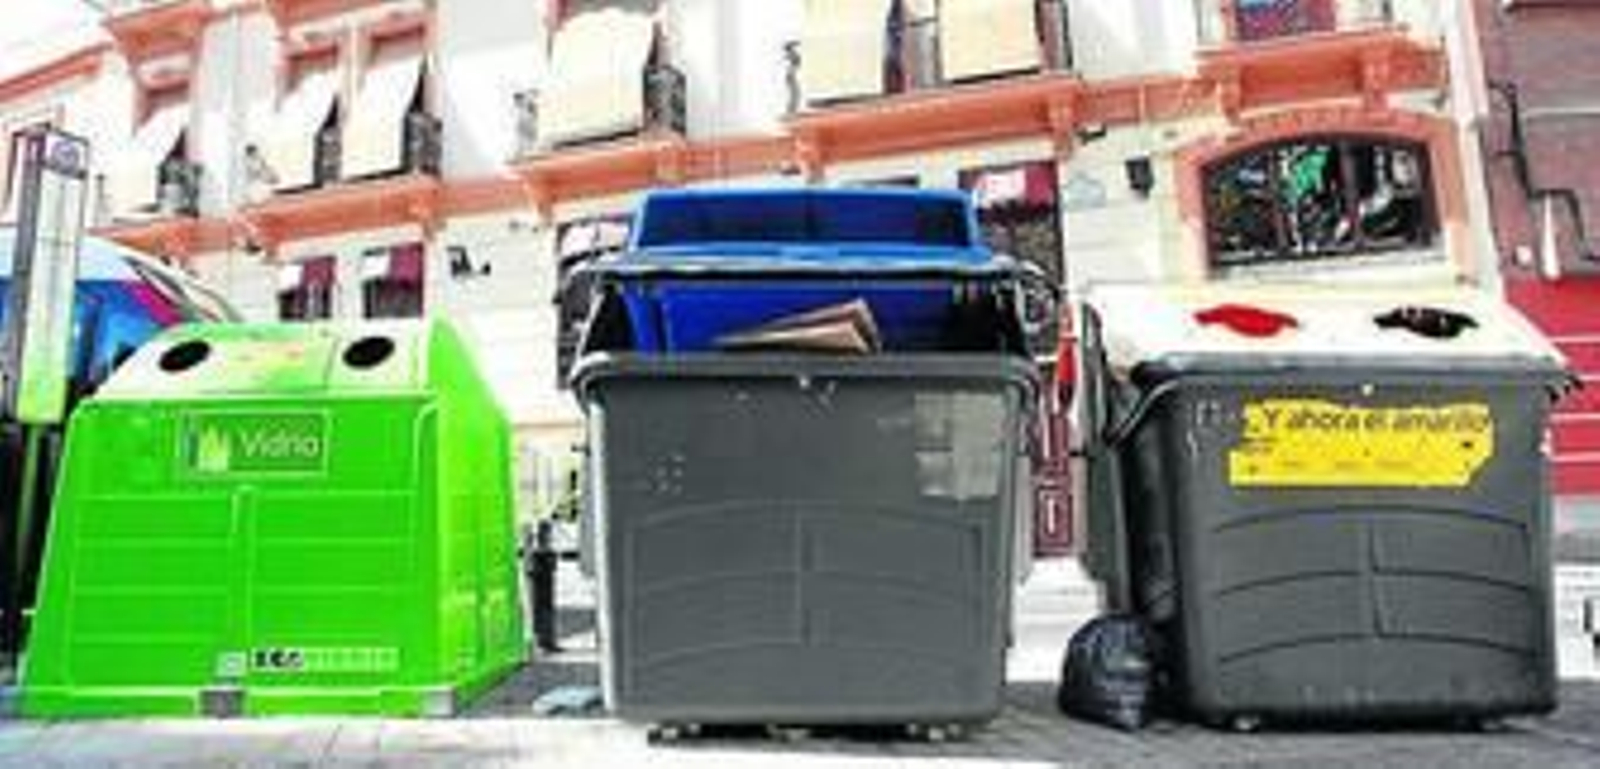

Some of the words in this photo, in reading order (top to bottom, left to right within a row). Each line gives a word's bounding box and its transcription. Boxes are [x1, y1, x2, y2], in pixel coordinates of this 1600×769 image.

[1263, 408, 1283, 429] Y
[1286, 407, 1360, 431] ahora
[239, 427, 320, 459] Vidrio
